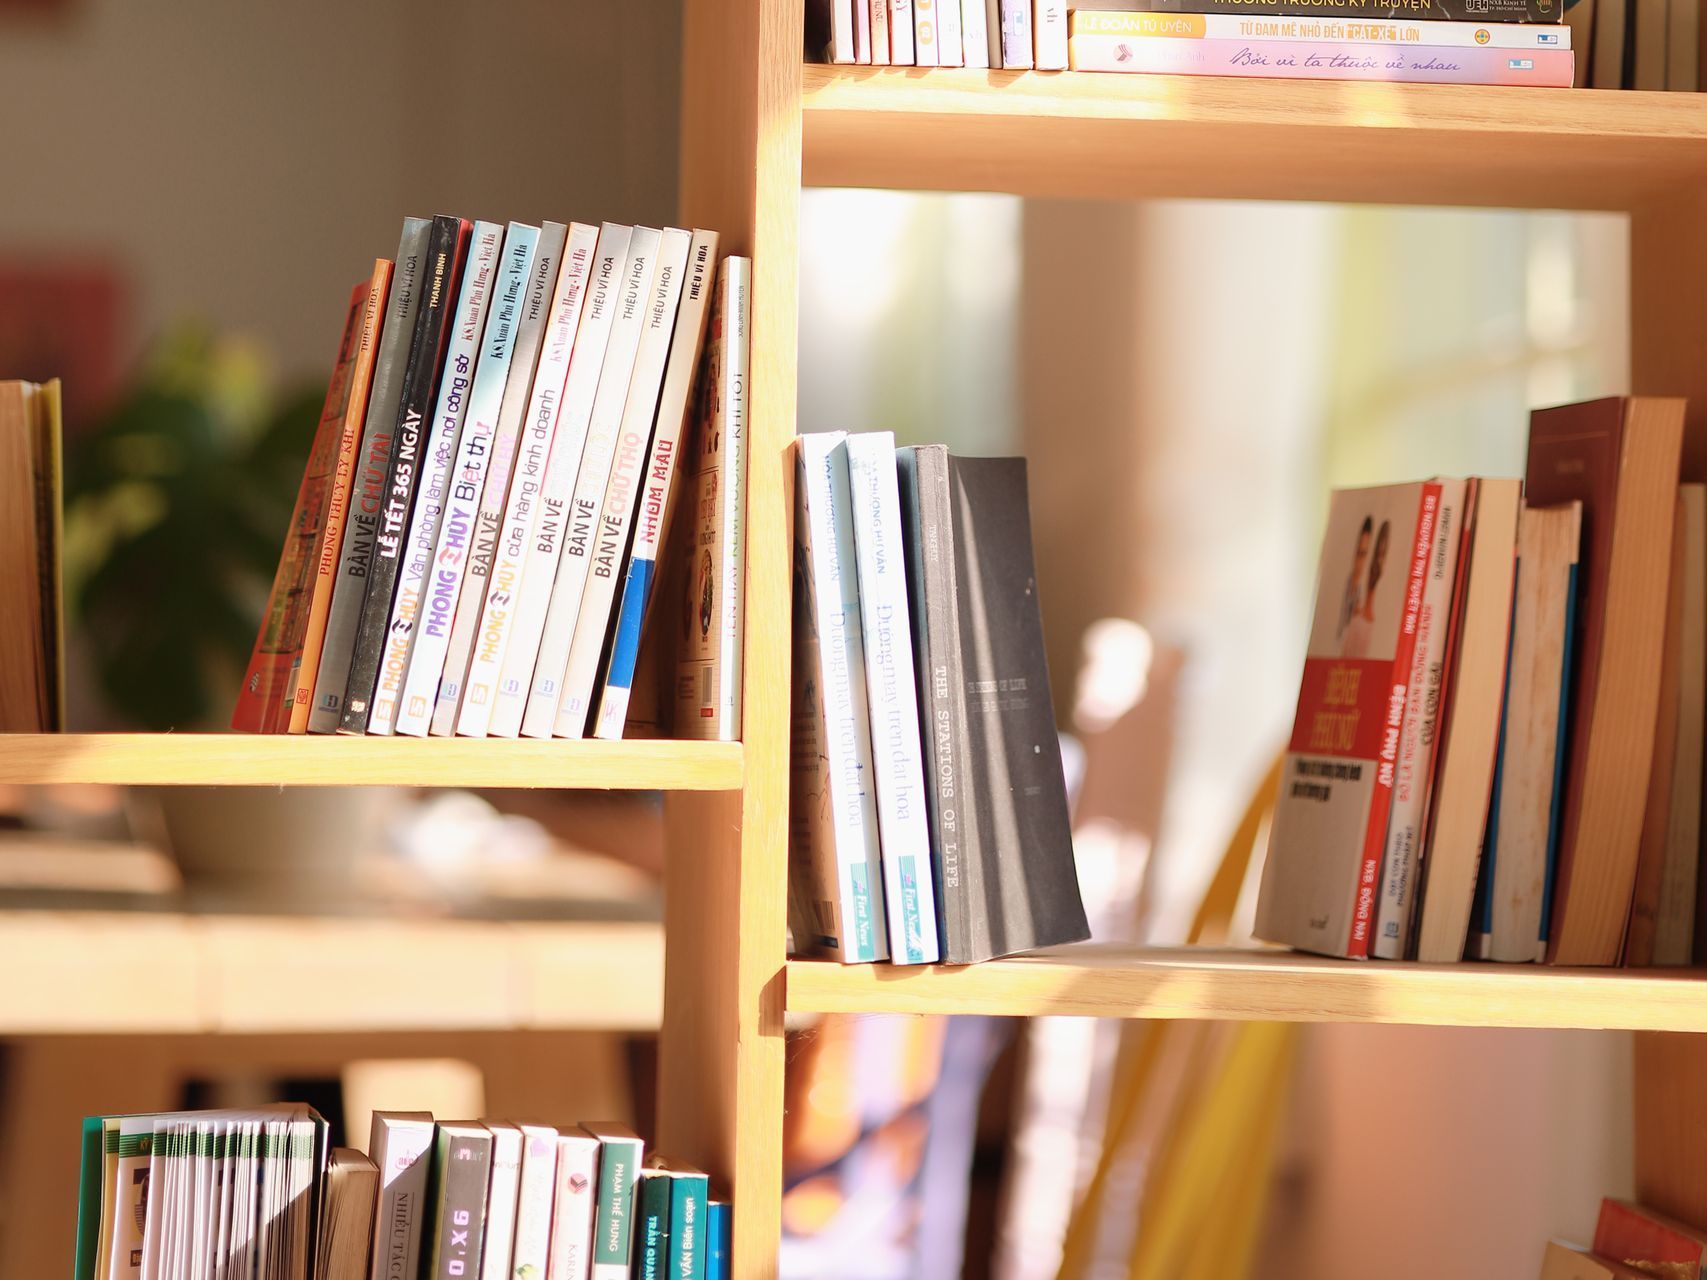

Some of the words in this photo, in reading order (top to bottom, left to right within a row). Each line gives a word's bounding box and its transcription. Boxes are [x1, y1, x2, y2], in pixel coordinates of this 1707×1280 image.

[1160, 17, 1192, 33] UYÊN
[1256, 23, 1279, 36] ĐAM
[1281, 22, 1297, 37] MÊ
[1324, 22, 1344, 38] ĐẾN
[1400, 26, 1420, 41] LỚN
[1413, 57, 1460, 71] nhau
[435, 253, 446, 274] BÌNH
[540, 257, 550, 278] HOA
[603, 256, 614, 277] HOA
[635, 256, 646, 277] HOA
[662, 266, 673, 287] HOA
[689, 275, 703, 301] THIỆU
[699, 245, 709, 262] HOA
[430, 276, 441, 308] THANH
[534, 279, 546, 289] VĨ
[596, 279, 609, 289] VĨ
[628, 279, 641, 289] VĨ
[656, 288, 669, 298] VĨ
[529, 292, 542, 320] THIỆU
[591, 291, 606, 320] THIỆU
[623, 291, 637, 320] THIỆU
[651, 301, 665, 329] THIỆU
[446, 377, 469, 413] công
[531, 389, 555, 440] doanh
[399, 409, 422, 463] NGÀY
[433, 440, 450, 469] việc
[523, 444, 543, 477] kinh
[652, 439, 674, 482] MÁU
[393, 466, 412, 498] 365
[425, 472, 442, 501] làm
[383, 499, 405, 533] TẾT
[515, 483, 538, 521] hàng
[575, 498, 595, 522] VỀ
[354, 514, 376, 542] VỀ
[416, 506, 441, 551] phòng
[479, 511, 500, 542] VỀ
[569, 523, 590, 557] BÀN
[602, 514, 623, 540] VỀ
[348, 543, 368, 578] BÀN
[377, 536, 399, 558] LỄ
[472, 543, 493, 577] BÀN
[595, 541, 618, 578] BÀN
[425, 570, 457, 638] PHONG
[479, 610, 507, 664] PHONG
[935, 666, 948, 698] THE
[1387, 684, 1407, 726] BỆNH
[938, 711, 954, 798] STATIONS
[1379, 728, 1400, 759] PHỤ
[943, 809, 955, 832] OF
[945, 842, 959, 887] LIFE
[855, 894, 867, 917] First
[1354, 920, 1367, 941] NAI
[612, 1163, 625, 1194] PHẠM
[609, 1219, 622, 1252] HƯNG
